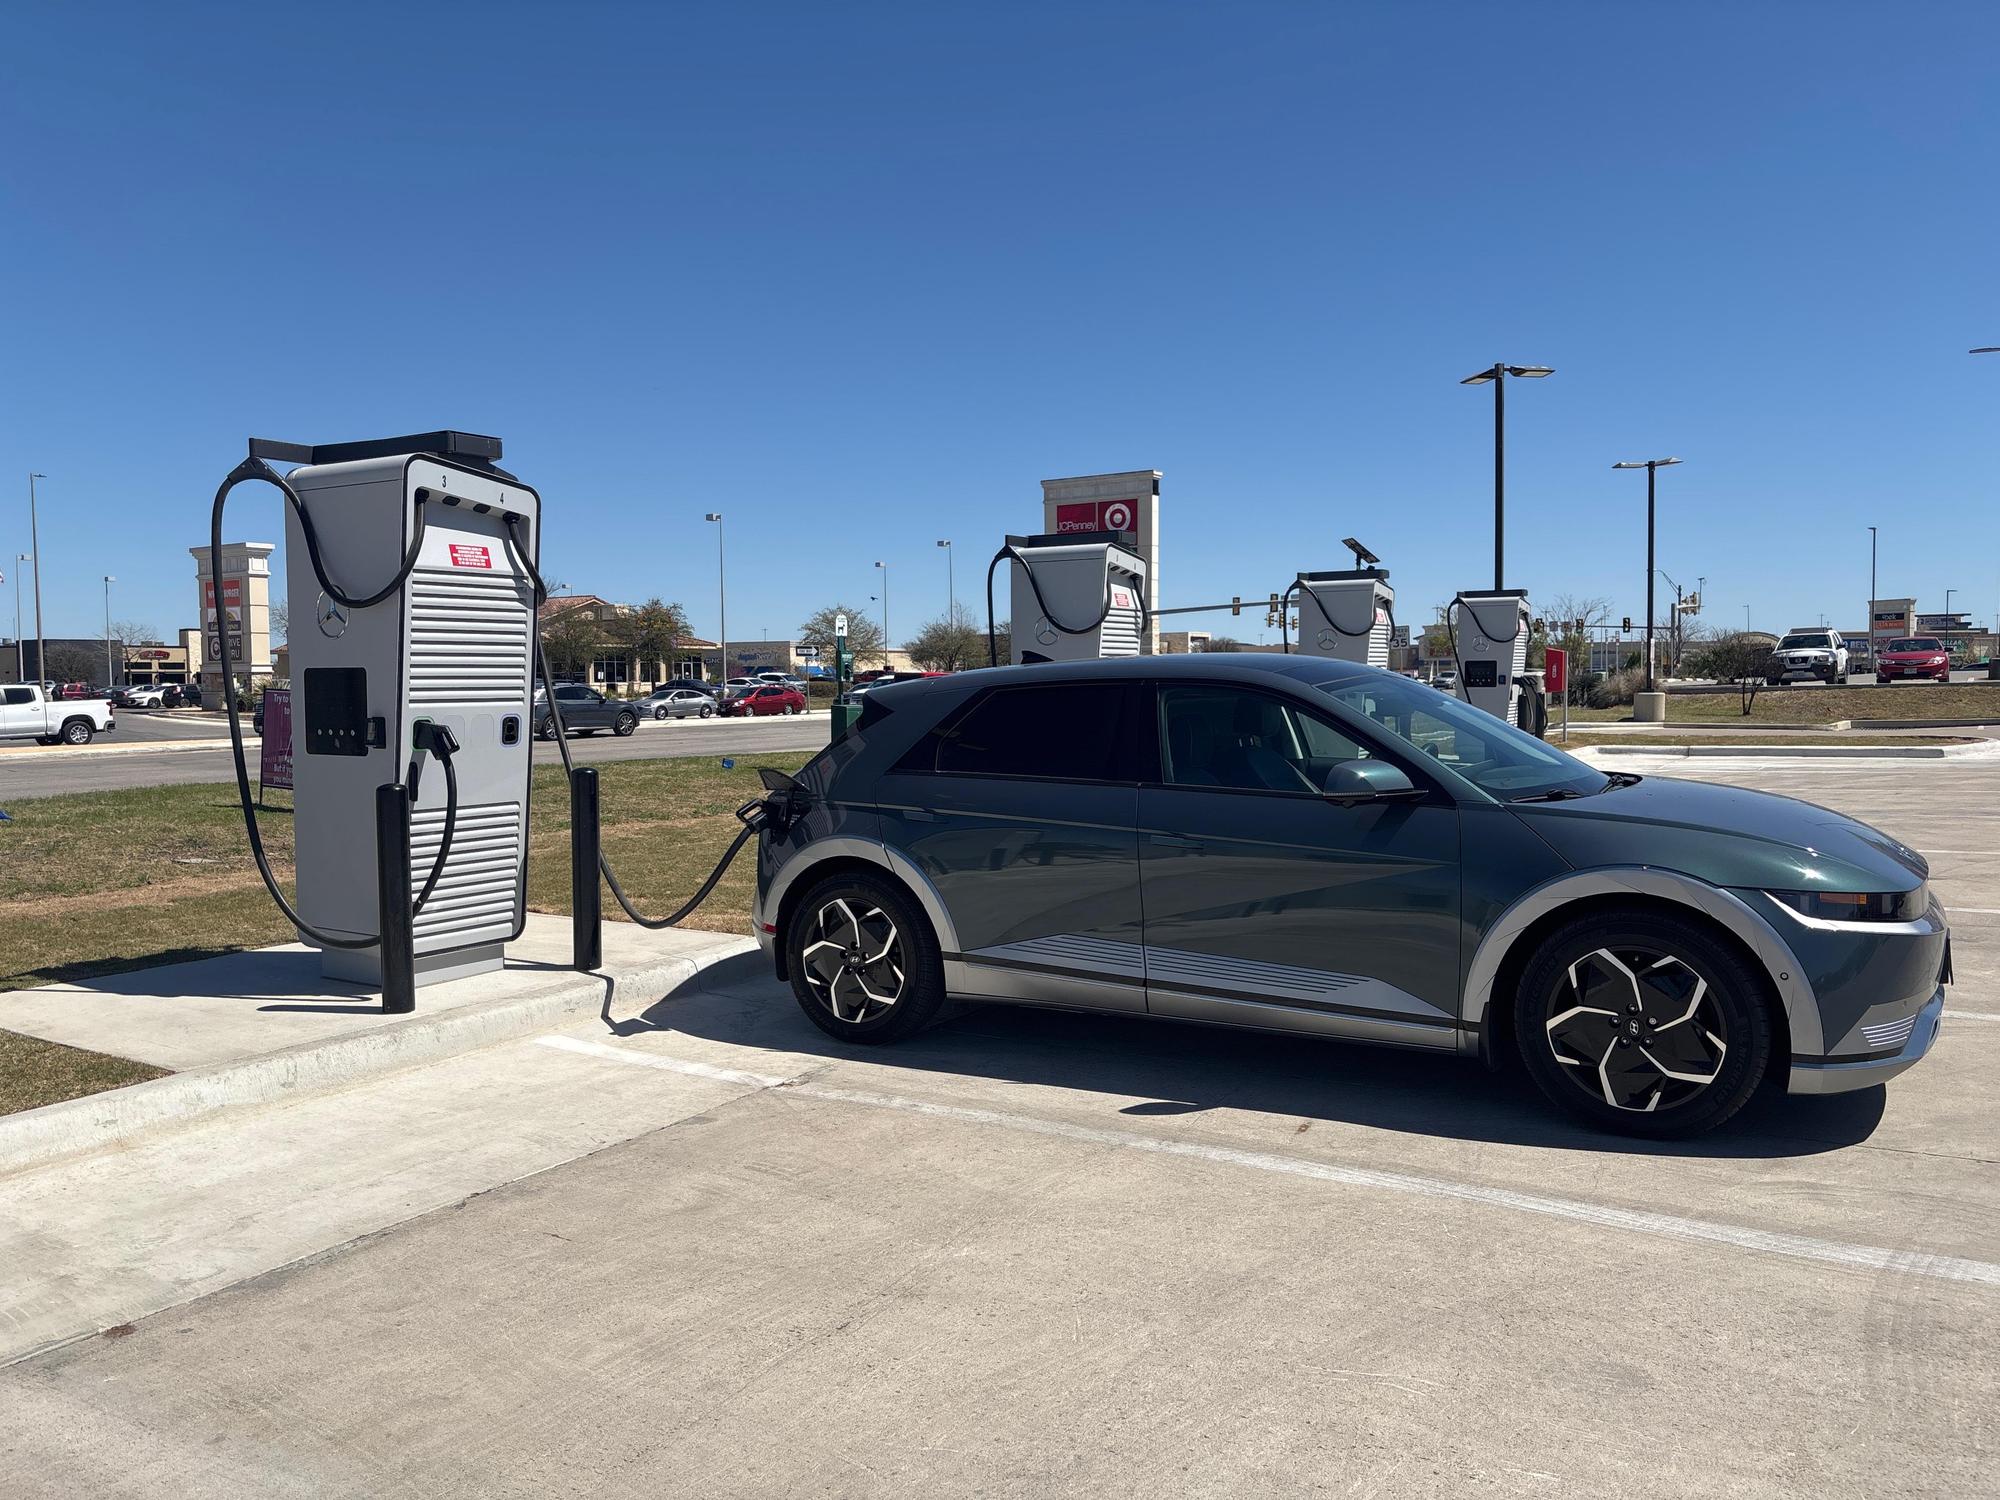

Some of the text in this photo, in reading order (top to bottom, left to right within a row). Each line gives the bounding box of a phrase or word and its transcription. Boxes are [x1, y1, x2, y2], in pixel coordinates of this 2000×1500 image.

[442, 475, 447, 488] 3
[500, 493, 504, 504] 4
[1057, 521, 1097, 531] JCPenney
[228, 638, 240, 646] RIVE
[1393, 638, 1407, 648] 35
[274, 694, 289, 704] Try to
[284, 706, 290, 715] to
